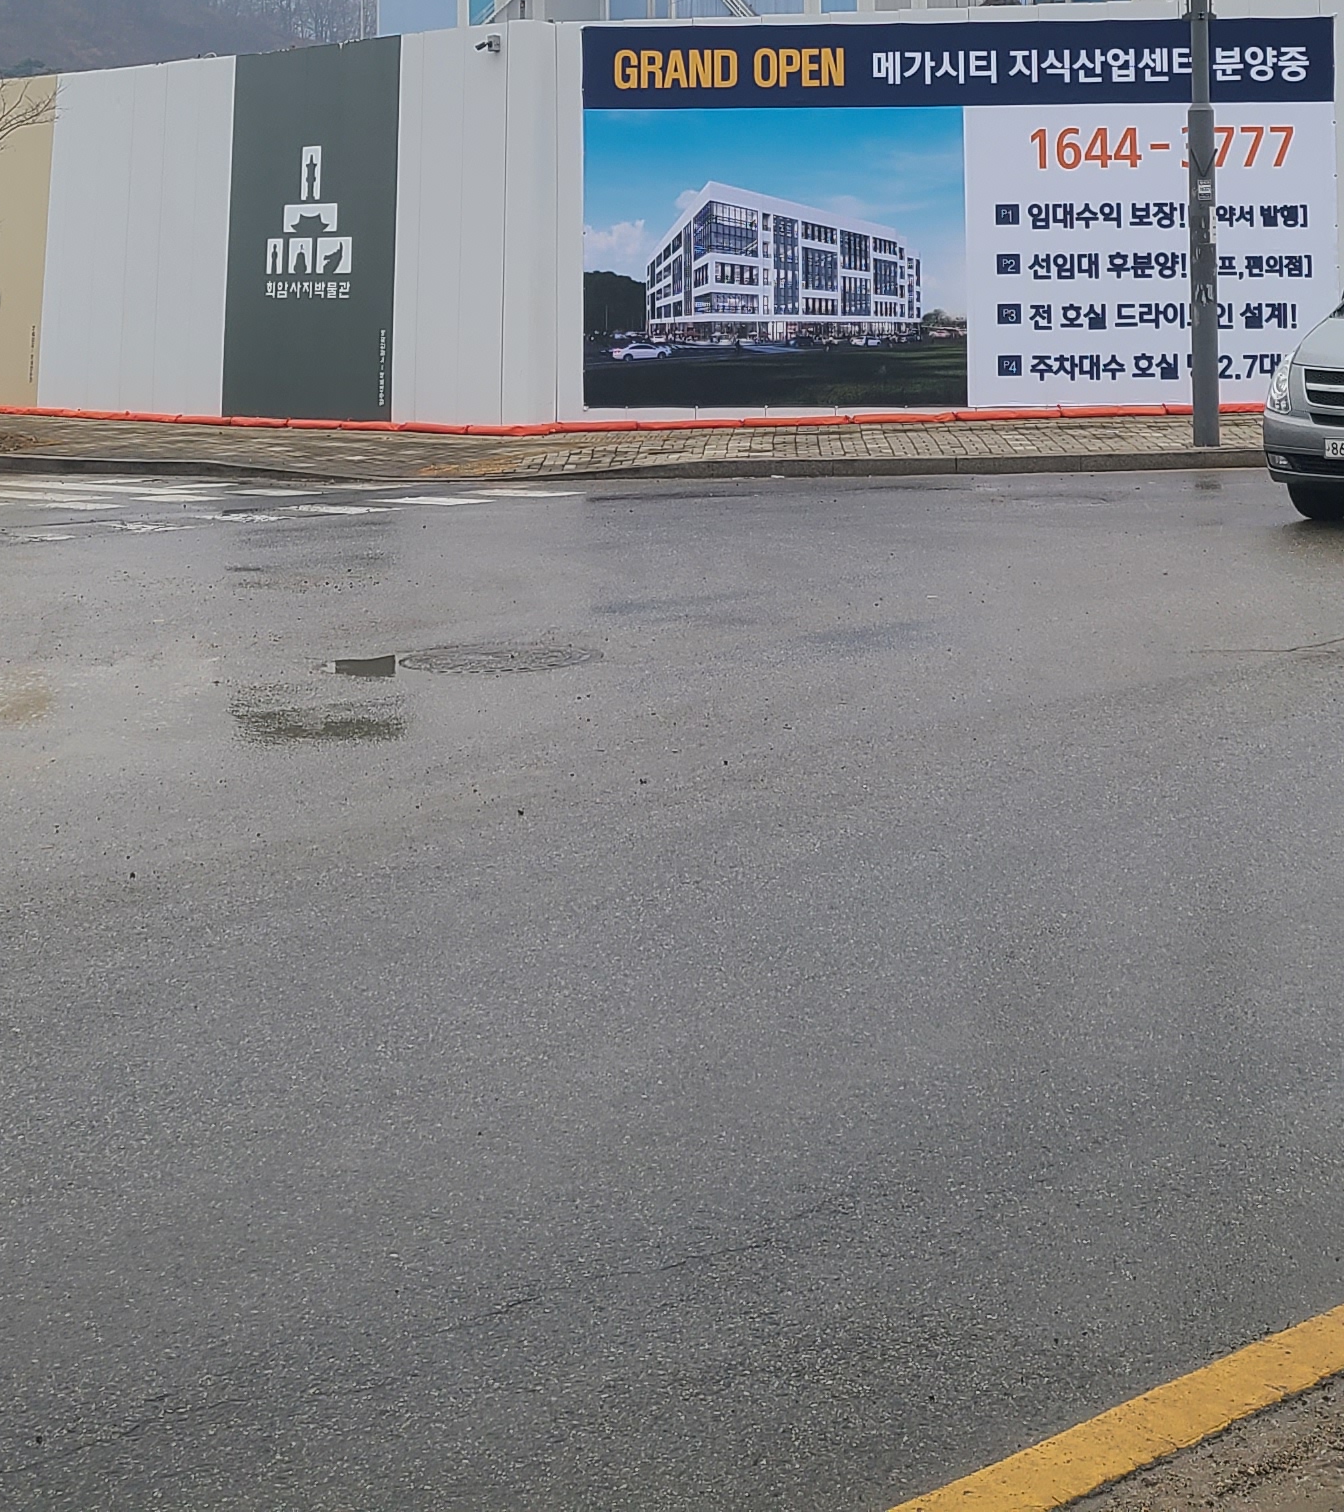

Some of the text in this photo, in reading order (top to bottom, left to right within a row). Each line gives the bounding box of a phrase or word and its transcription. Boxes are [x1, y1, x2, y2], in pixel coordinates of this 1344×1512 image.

[614, 47, 845, 89] GRAND OPEN
[872, 49, 999, 85] 메가시티
[1212, 46, 1310, 82] 분양중
[1030, 126, 1295, 170] 1644-777
[1027, 202, 1122, 230] 임대수익
[1129, 202, 1186, 229] 보장!
[1216, 205, 1255, 227] 약서
[1027, 253, 1100, 280] 선임대
[1106, 252, 1188, 279] 후분양!
[1216, 254, 1313, 280] 프,편의점]
[265, 280, 351, 299] 회암사지박물관
[1028, 304, 1052, 330] 전
[1059, 303, 1107, 330] 호실
[1114, 302, 1234, 329] 드라이인
[1239, 302, 1298, 329] 설계!
[1029, 355, 1126, 381] 주차대수
[1132, 353, 1179, 380] 호실
[1218, 353, 1286, 380] 2.7대
